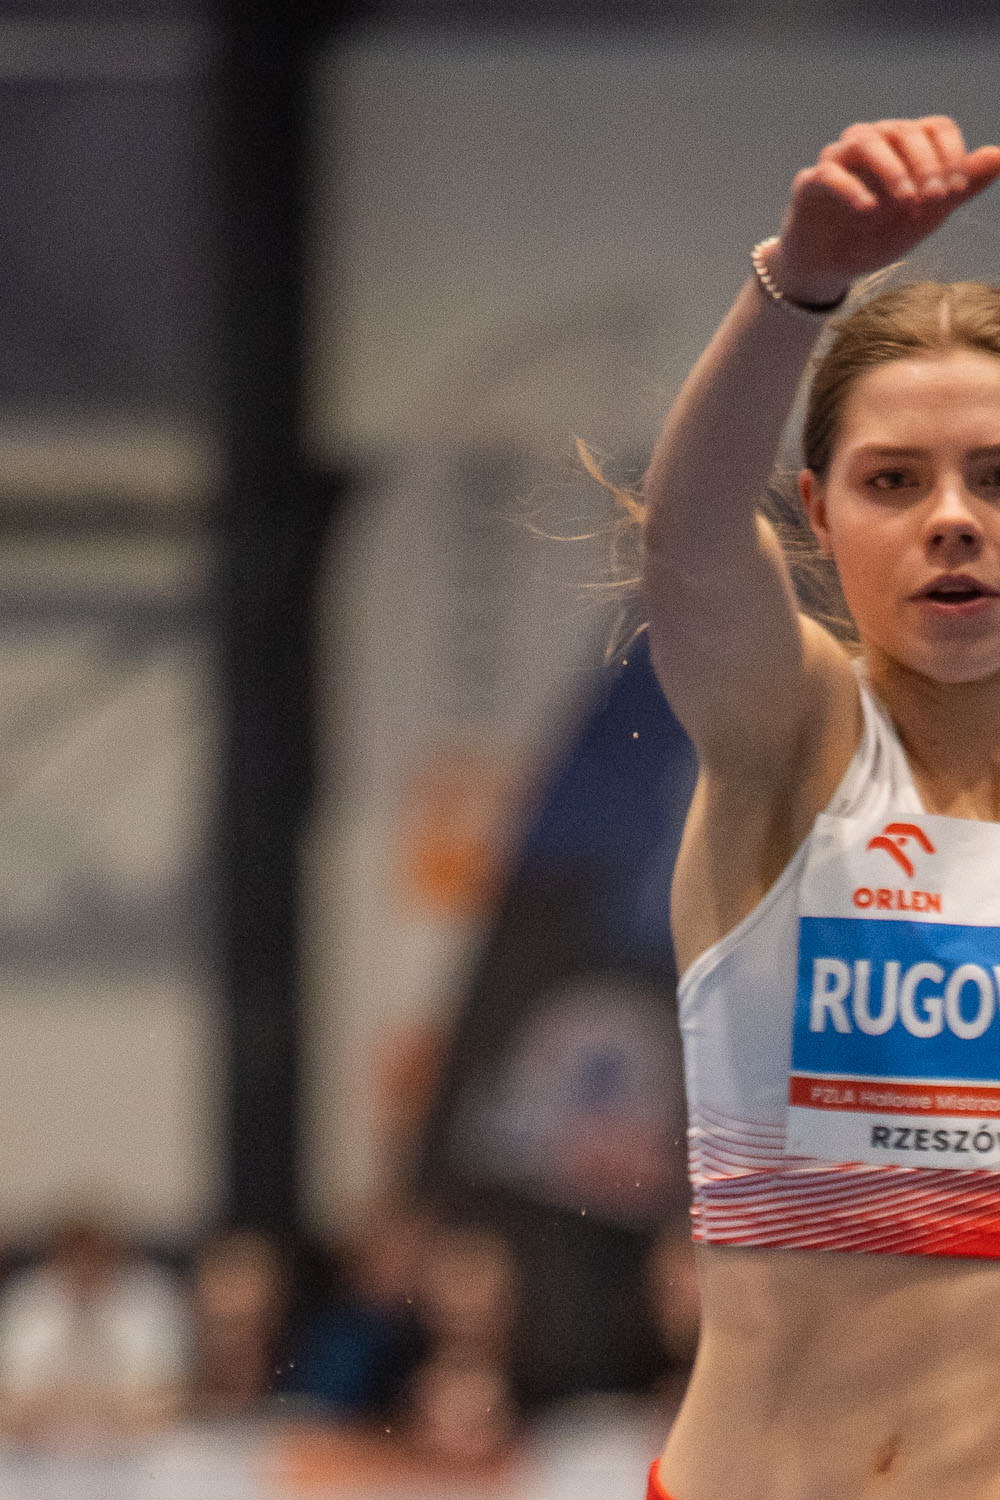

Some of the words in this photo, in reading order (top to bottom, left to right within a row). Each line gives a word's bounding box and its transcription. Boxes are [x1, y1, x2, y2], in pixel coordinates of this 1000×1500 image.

[852, 887, 942, 913] ORLEN
[811, 1086, 855, 1104] PZLA
[860, 1090, 932, 1110] Halowe
